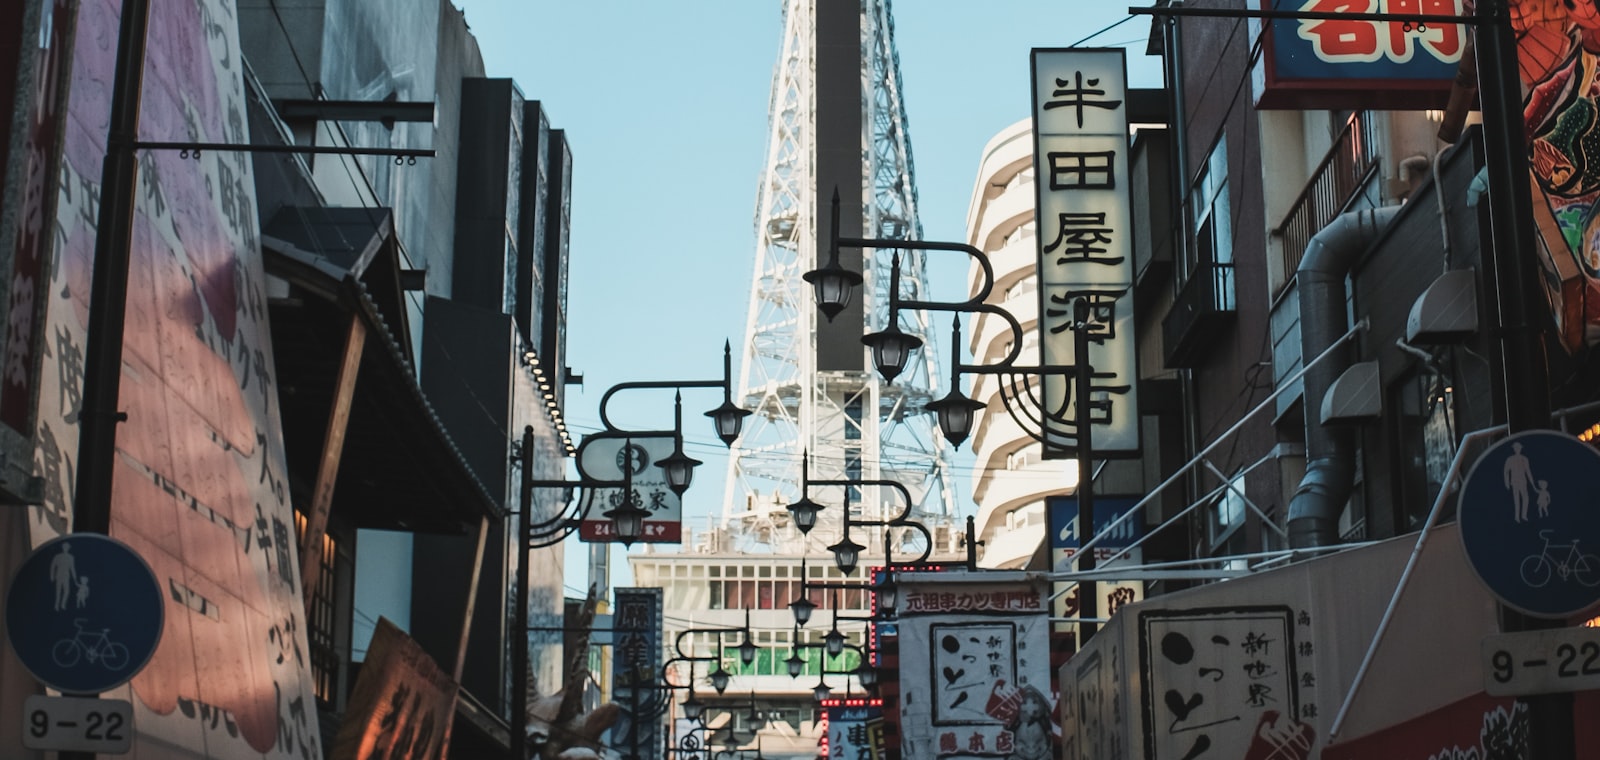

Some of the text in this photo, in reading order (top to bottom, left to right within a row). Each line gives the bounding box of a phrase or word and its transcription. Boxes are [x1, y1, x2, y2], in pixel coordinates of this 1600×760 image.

[1044, 71, 1131, 425] 半田屋酒店
[1059, 510, 1134, 541] Aahi
[906, 592, 1041, 610] 元祖串カツ専門店
[986, 635, 1004, 677] 新世界
[1241, 632, 1278, 707] 新世界
[1297, 610, 1318, 718] 商標登録
[29, 710, 124, 741] 9-22
